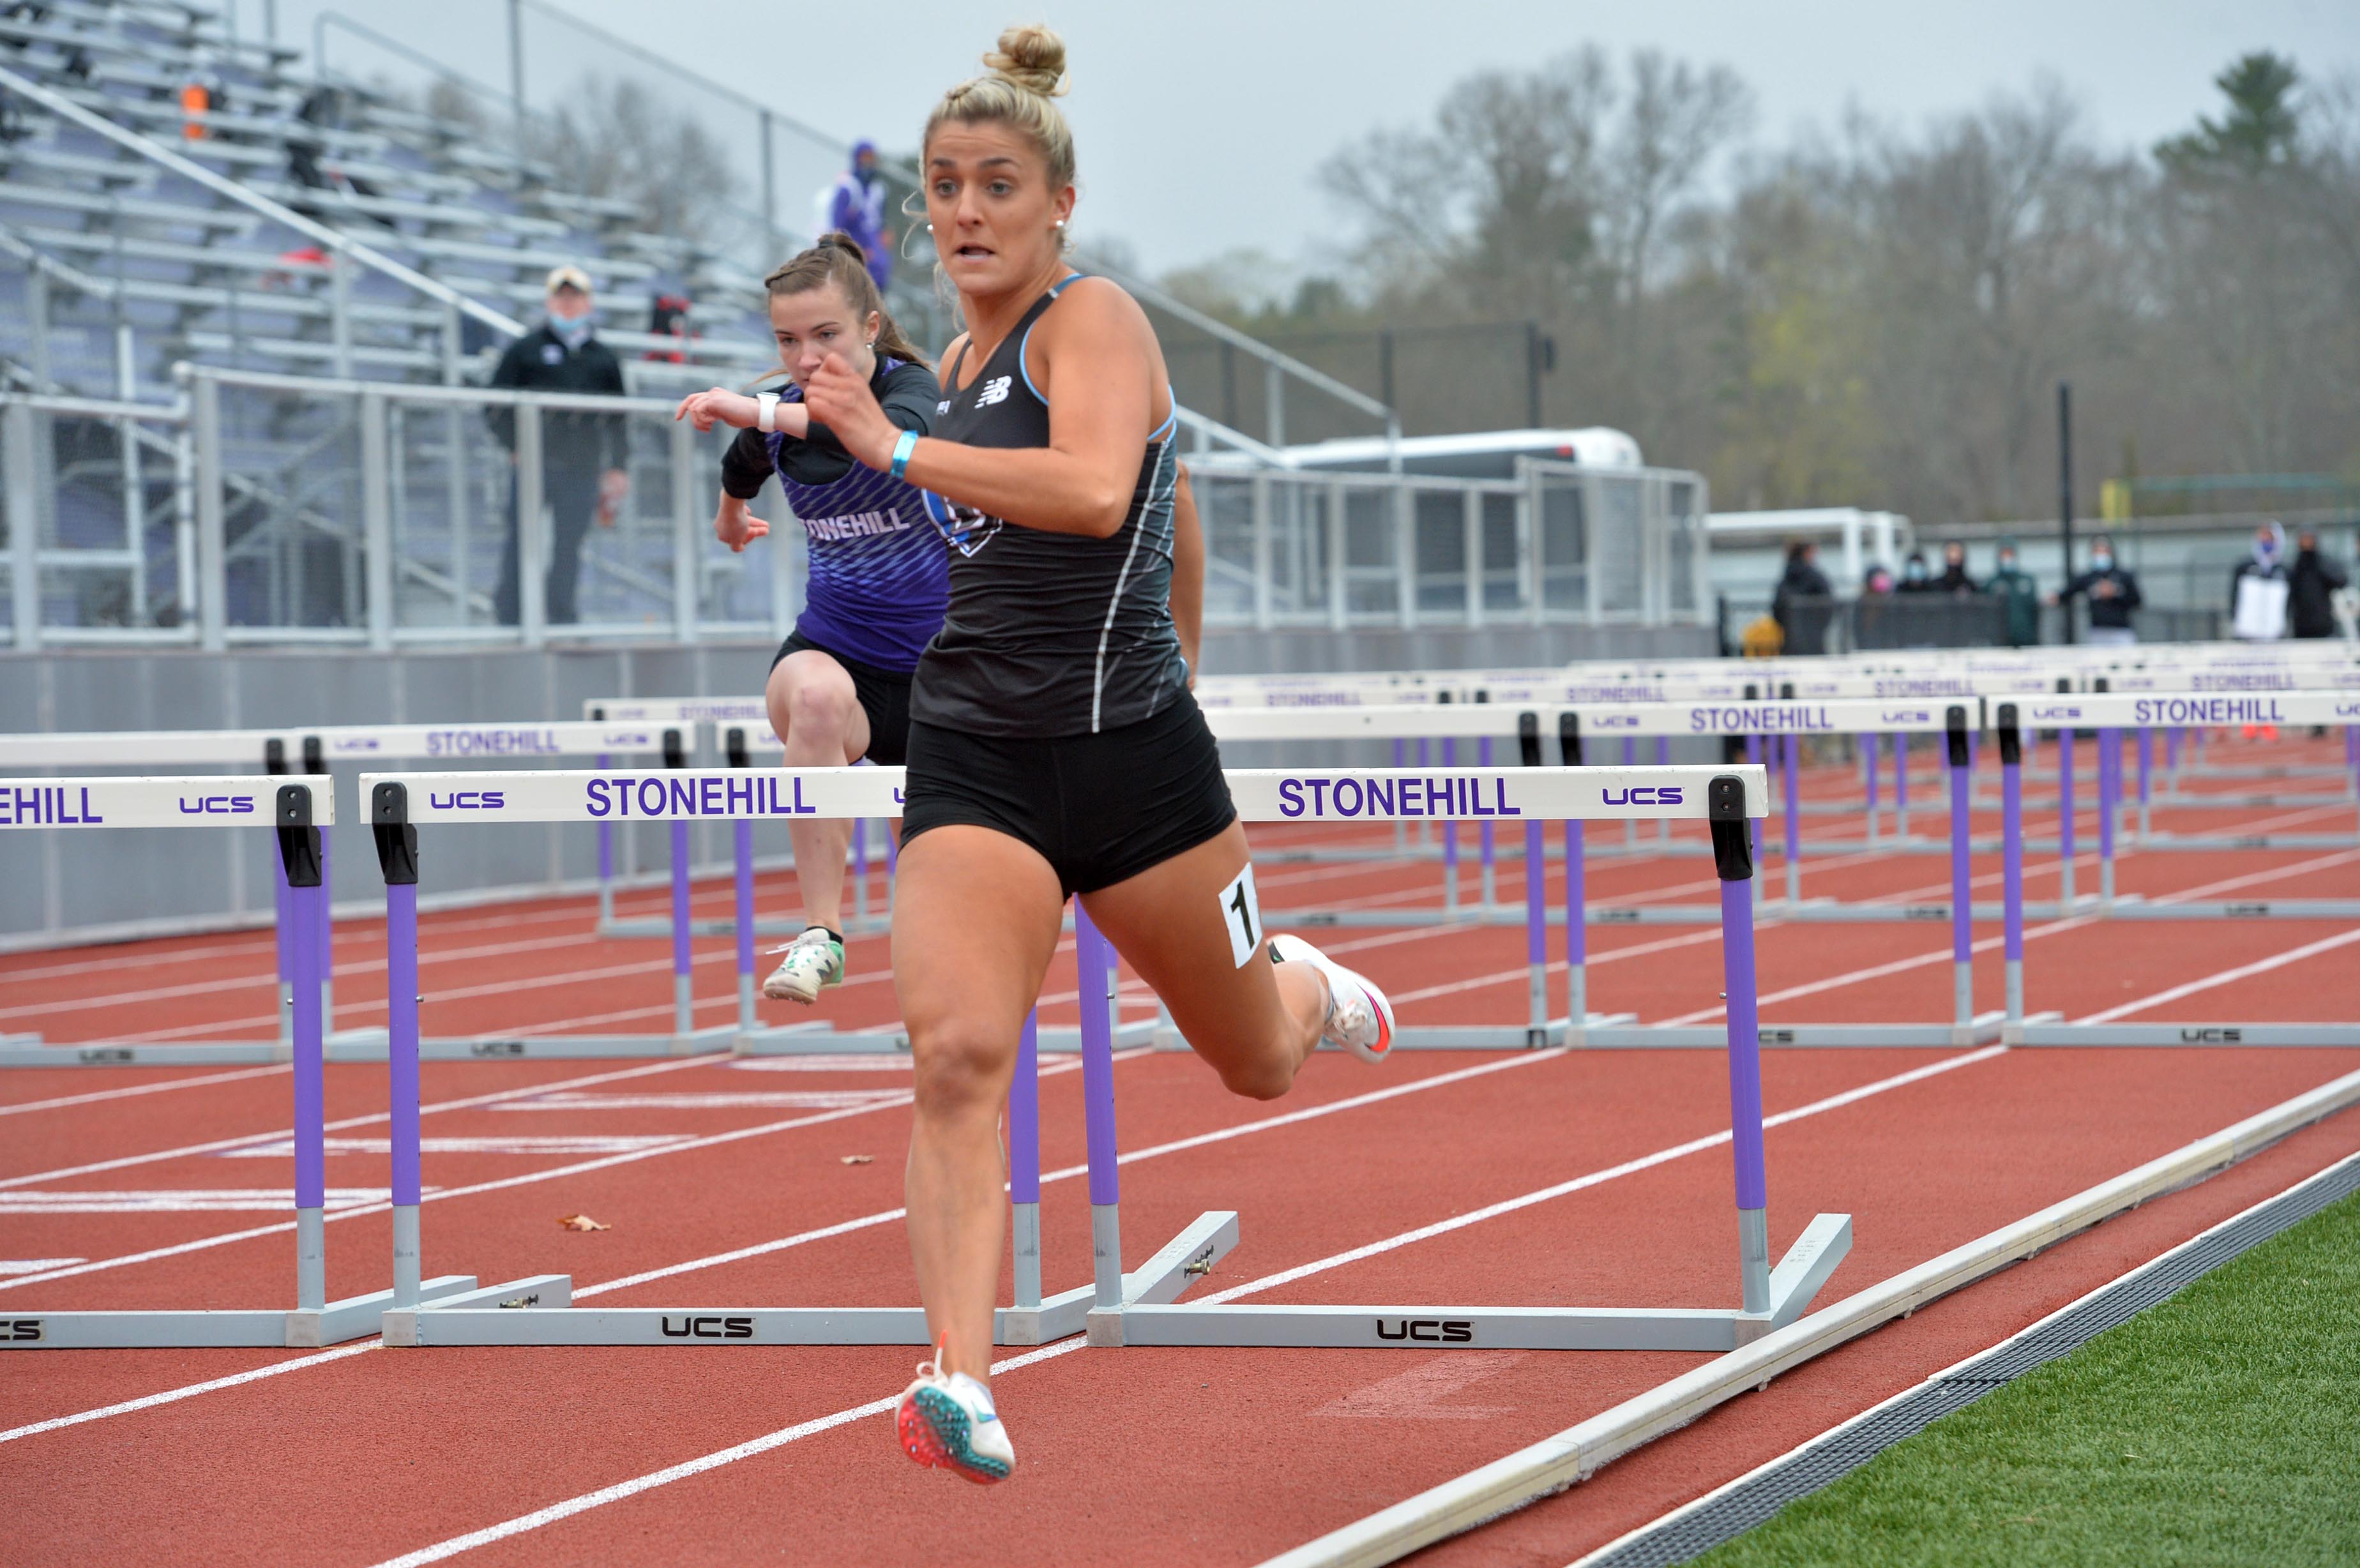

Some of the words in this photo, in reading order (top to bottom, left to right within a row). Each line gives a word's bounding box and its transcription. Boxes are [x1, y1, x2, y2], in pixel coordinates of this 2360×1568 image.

[1691, 707, 1834, 733] STONEHILL
[1882, 711, 1931, 723] UCS
[2135, 698, 2285, 723] STONEHILL
[427, 729, 560, 755] STONEHILL
[179, 796, 255, 814] UCS
[431, 792, 506, 809] UCS
[586, 777, 816, 816] STONEHILL
[1278, 777, 1521, 817] STONEHILL
[1602, 787, 1684, 806] UCS
[1230, 880, 1255, 951] 1
[2182, 1029, 2241, 1043] UCS
[662, 1316, 755, 1338] UCS
[1377, 1319, 1474, 1342] UCS
